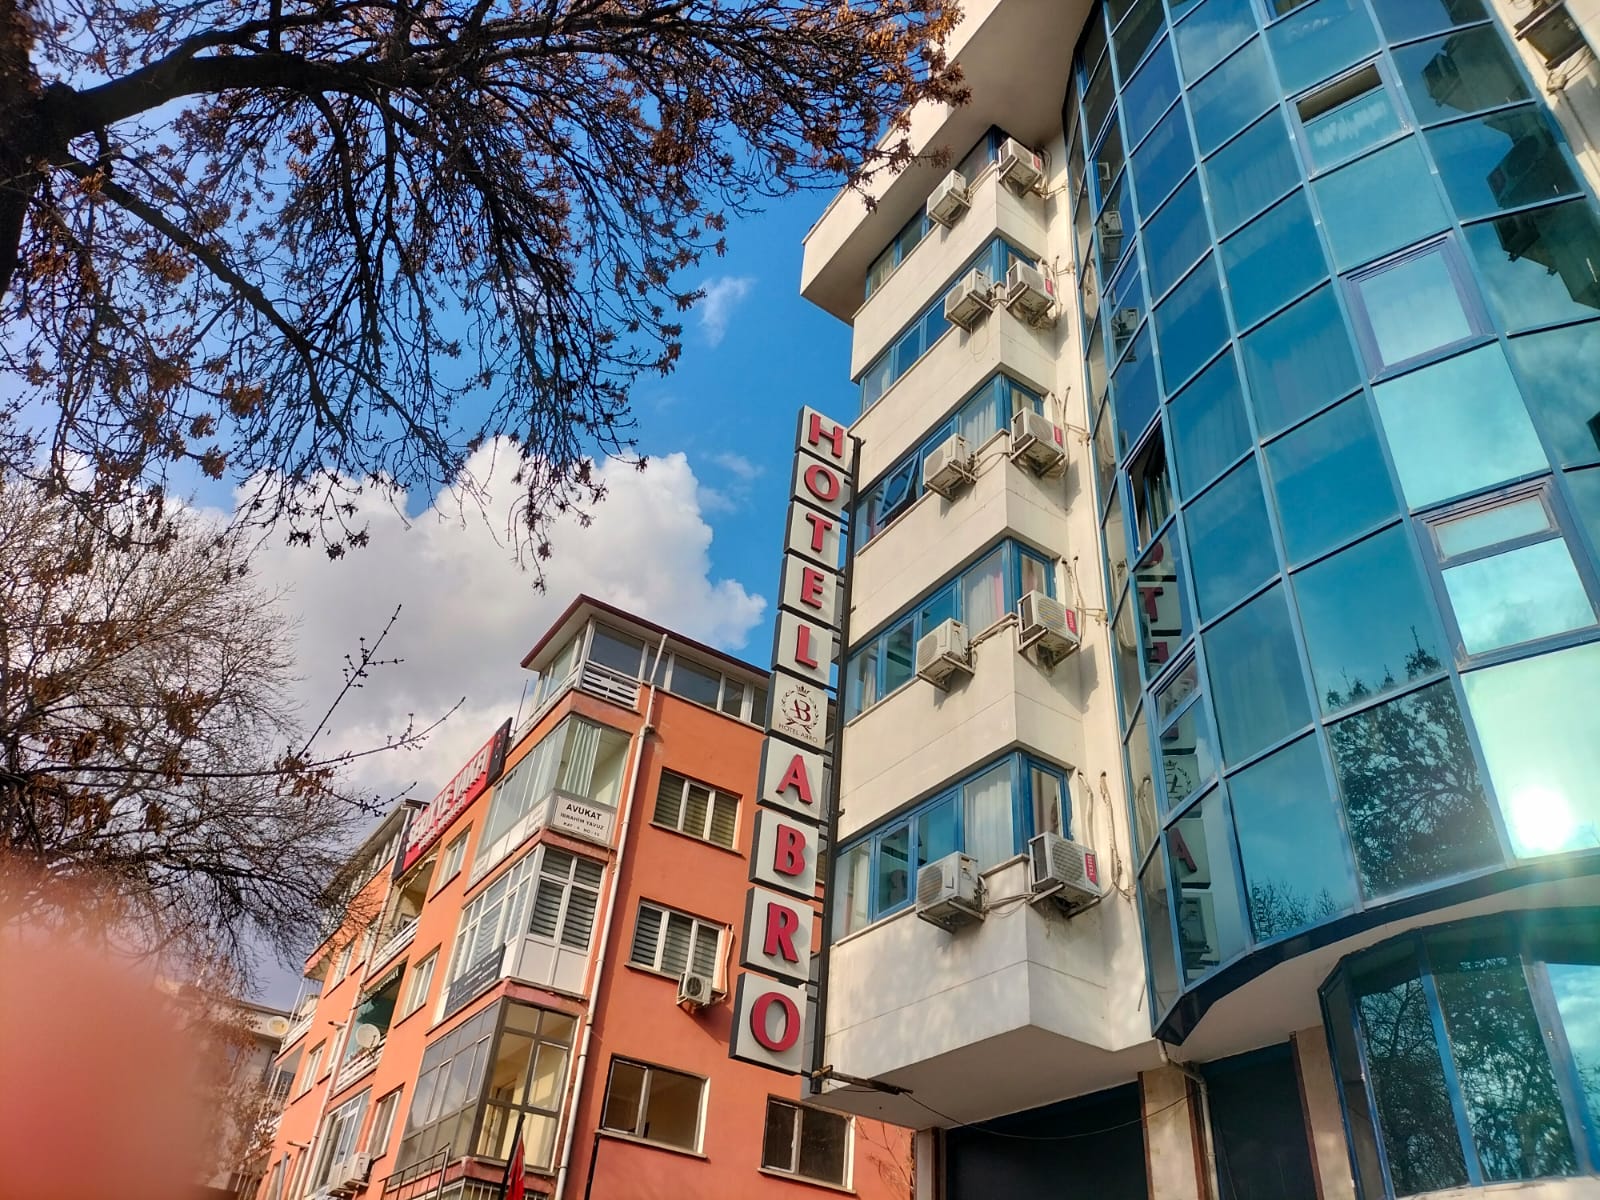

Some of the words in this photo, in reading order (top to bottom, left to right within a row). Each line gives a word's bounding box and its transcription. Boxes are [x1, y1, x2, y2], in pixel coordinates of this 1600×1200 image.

[795, 412, 844, 670] HOTEL
[778, 723, 799, 736] HOTEL
[566, 803, 602, 820] AVUKAT
[750, 753, 813, 1052] ABRO
